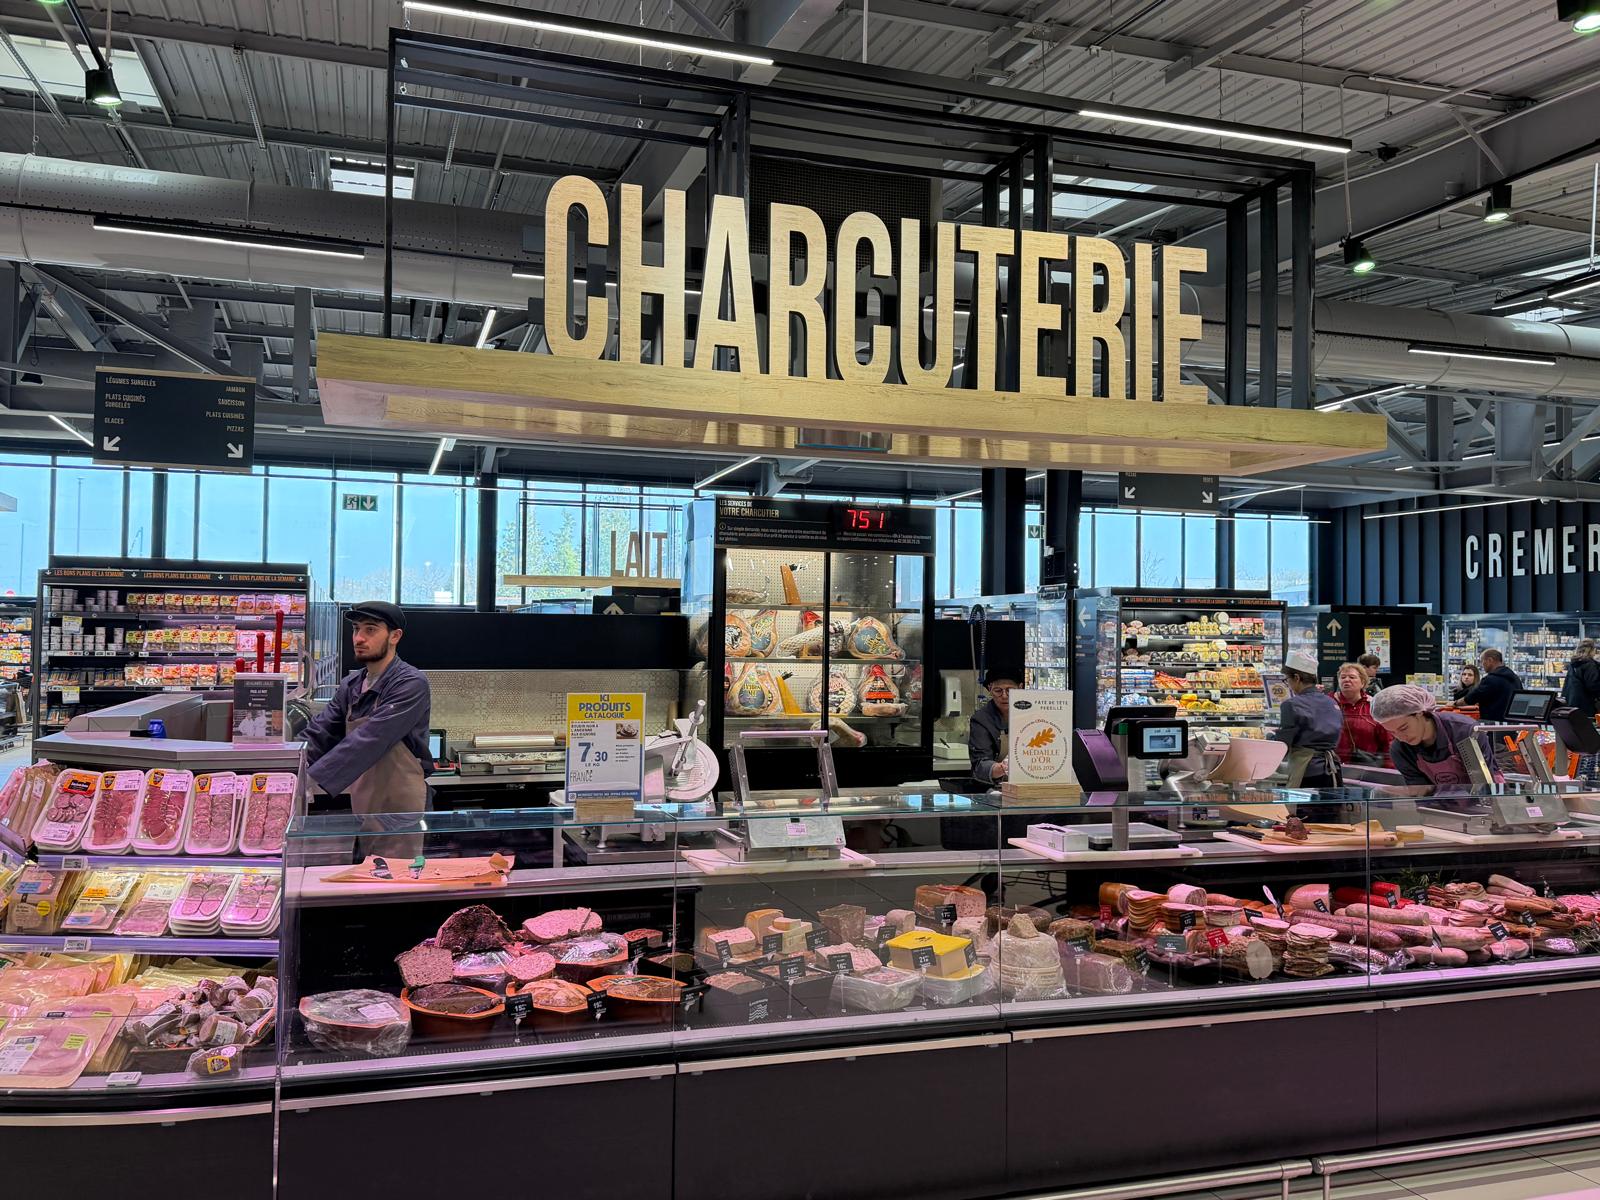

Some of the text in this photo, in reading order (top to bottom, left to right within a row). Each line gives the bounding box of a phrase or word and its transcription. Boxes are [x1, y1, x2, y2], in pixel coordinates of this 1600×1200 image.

[544, 174, 1209, 406] CHARCUTERIE
[105, 377, 157, 388] LÉGUMES SURGELÉS
[225, 386, 246, 394] JAMBON
[105, 393, 146, 403] PLATS CUISINÉS
[217, 398, 246, 407] SAUCISSON
[104, 401, 131, 409] SURGELÉS
[205, 411, 245, 420] PLATS CUISINÉS
[104, 417, 125, 425] GLACES
[226, 425, 245, 433] PIZZAS
[719, 507, 780, 518] VOTRE CHARCUTIER
[847, 509, 885, 529] 751
[610, 530, 668, 578] LAIT
[54, 569, 63, 577] LES
[600, 694, 610, 702] ICI
[578, 702, 632, 711] PRODUITS
[1031, 756, 1051, 764] D'OR
